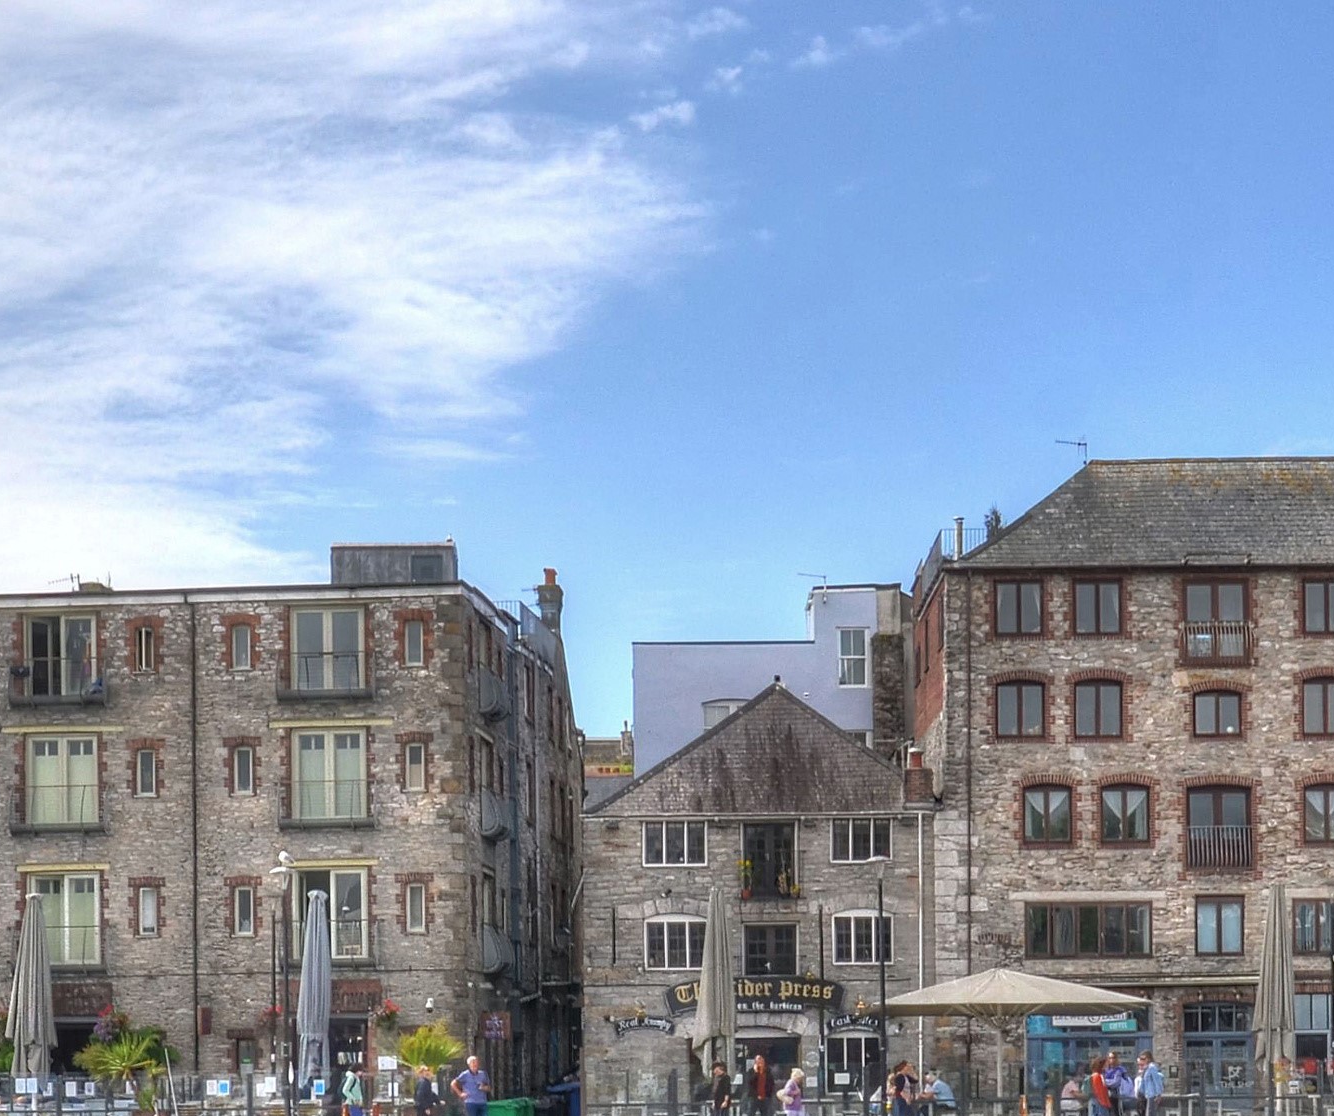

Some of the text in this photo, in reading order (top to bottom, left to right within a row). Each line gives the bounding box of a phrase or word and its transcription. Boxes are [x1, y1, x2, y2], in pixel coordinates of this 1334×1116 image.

[675, 979, 835, 1003] Th ider Press
